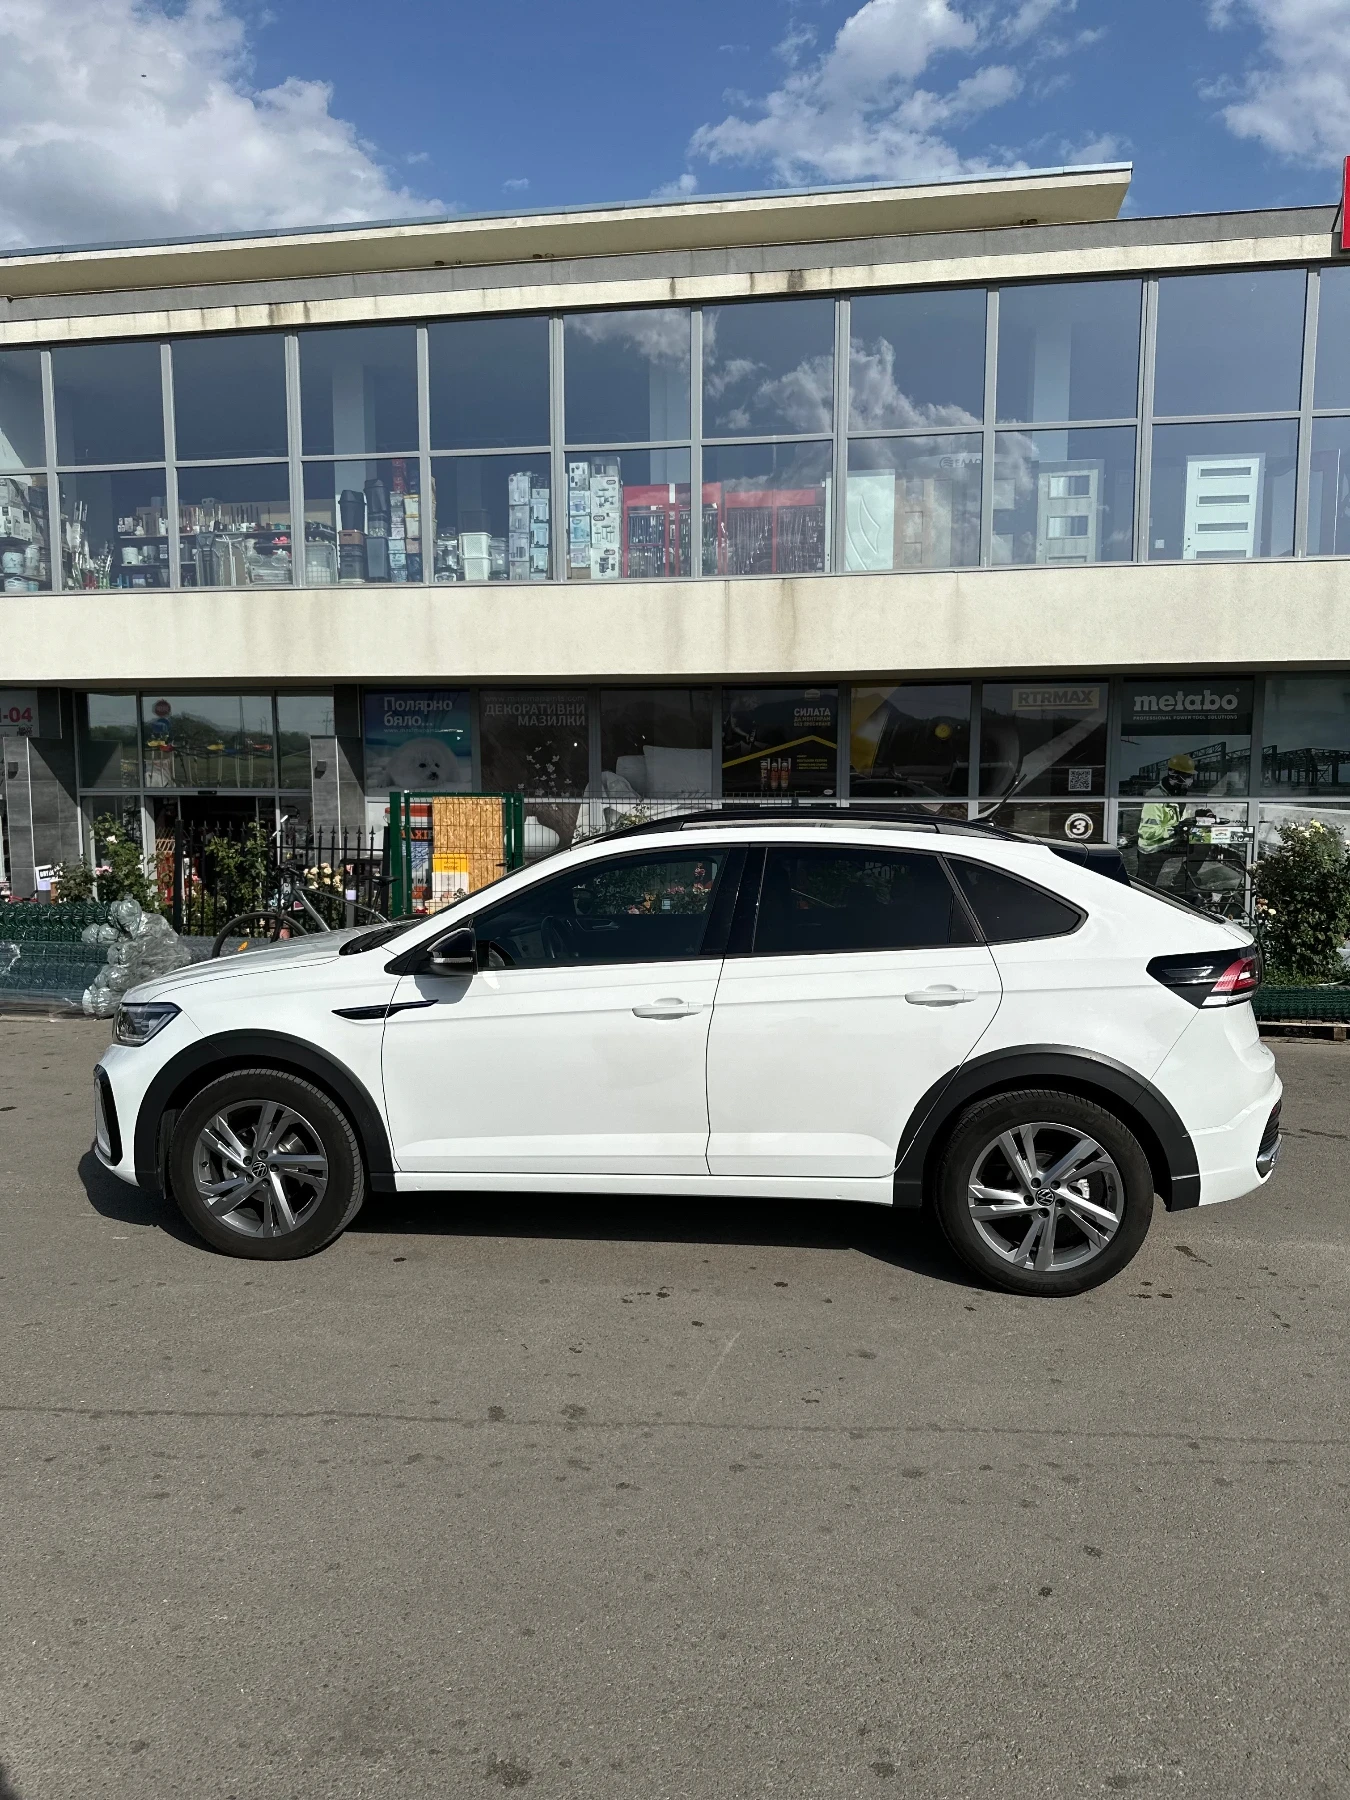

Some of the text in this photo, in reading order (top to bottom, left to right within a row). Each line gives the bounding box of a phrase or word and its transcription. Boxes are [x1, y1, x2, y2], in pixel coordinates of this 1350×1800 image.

[1017, 691, 1093, 704] RTRMAX
[1133, 690, 1238, 711] metabo
[384, 697, 453, 714] Полярно
[485, 704, 585, 716] ДЕКОРАТИВНИ
[794, 708, 831, 716] СИЛАТА
[518, 715, 585, 726] МАЗИЛКИ
[1072, 820, 1087, 834] 3
